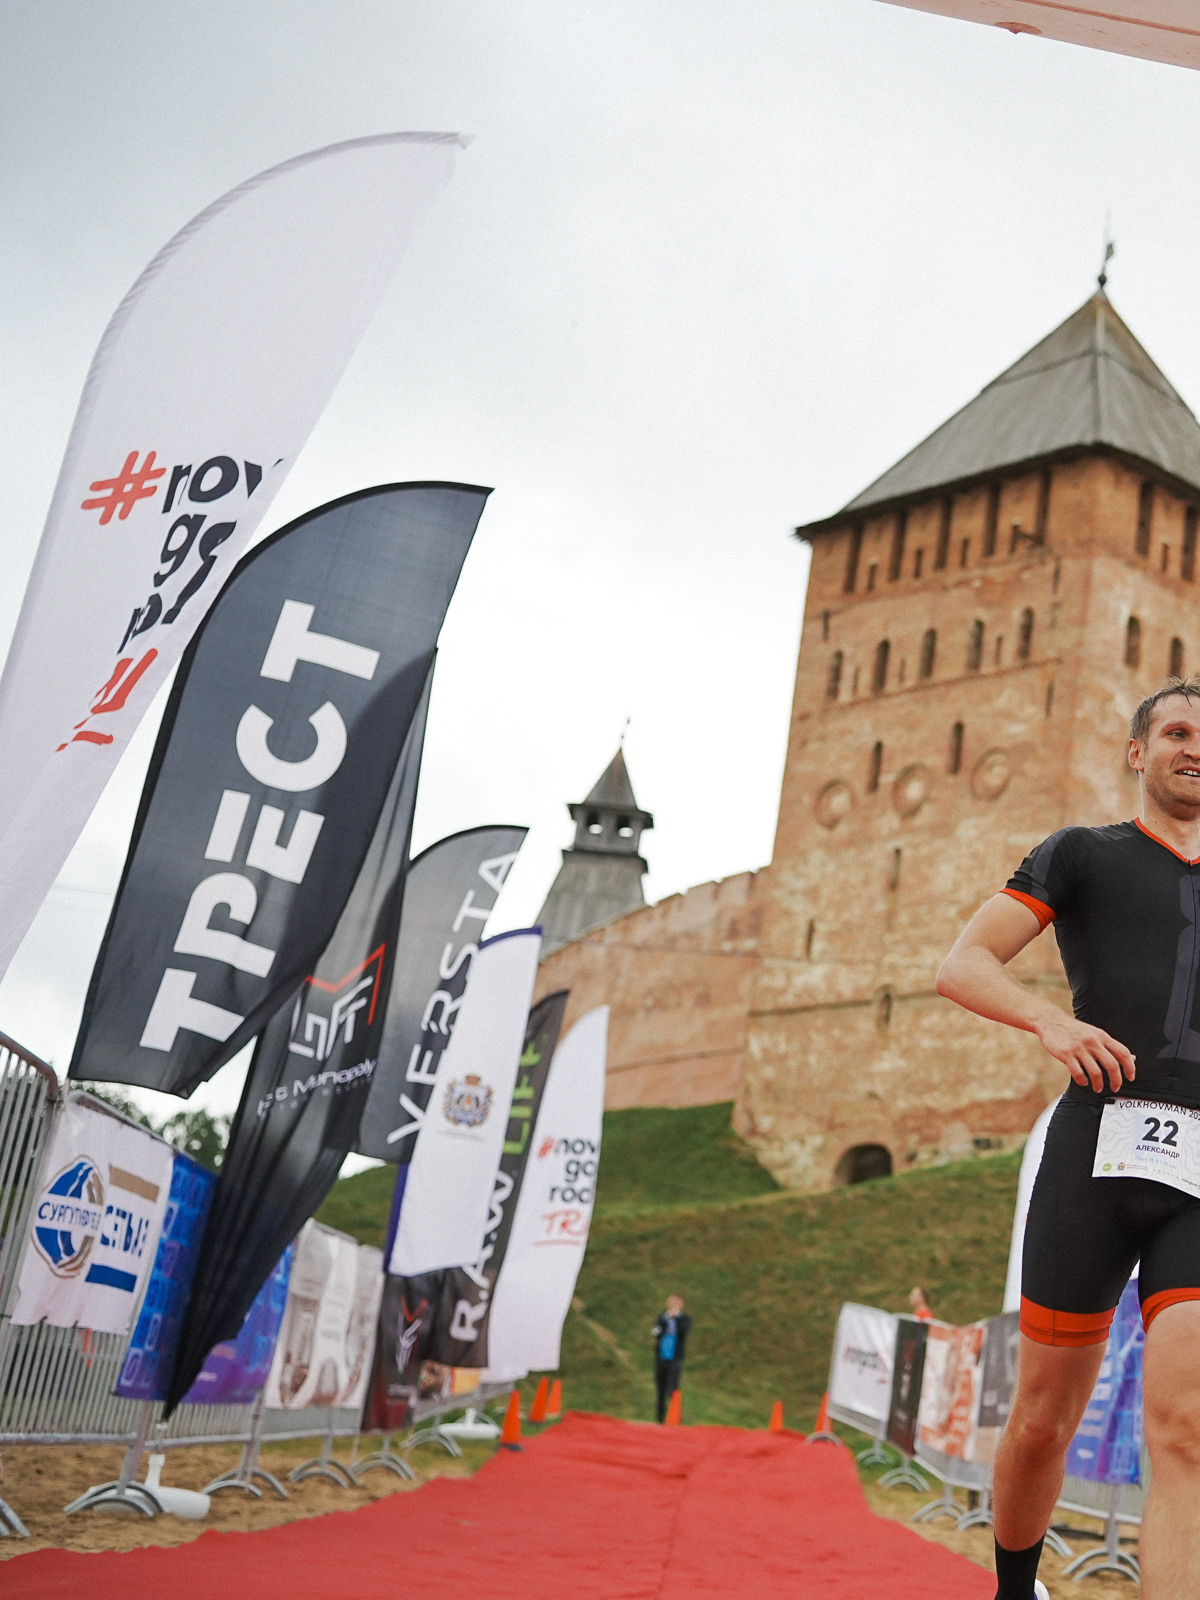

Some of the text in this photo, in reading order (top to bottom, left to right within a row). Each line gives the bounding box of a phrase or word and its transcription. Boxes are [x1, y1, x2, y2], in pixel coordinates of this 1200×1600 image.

[1119, 1100, 1187, 1116] VOLKHOVMAN
[1142, 1117, 1179, 1147] 22
[1135, 1144, 1181, 1159] АЛЕКСАНДР
